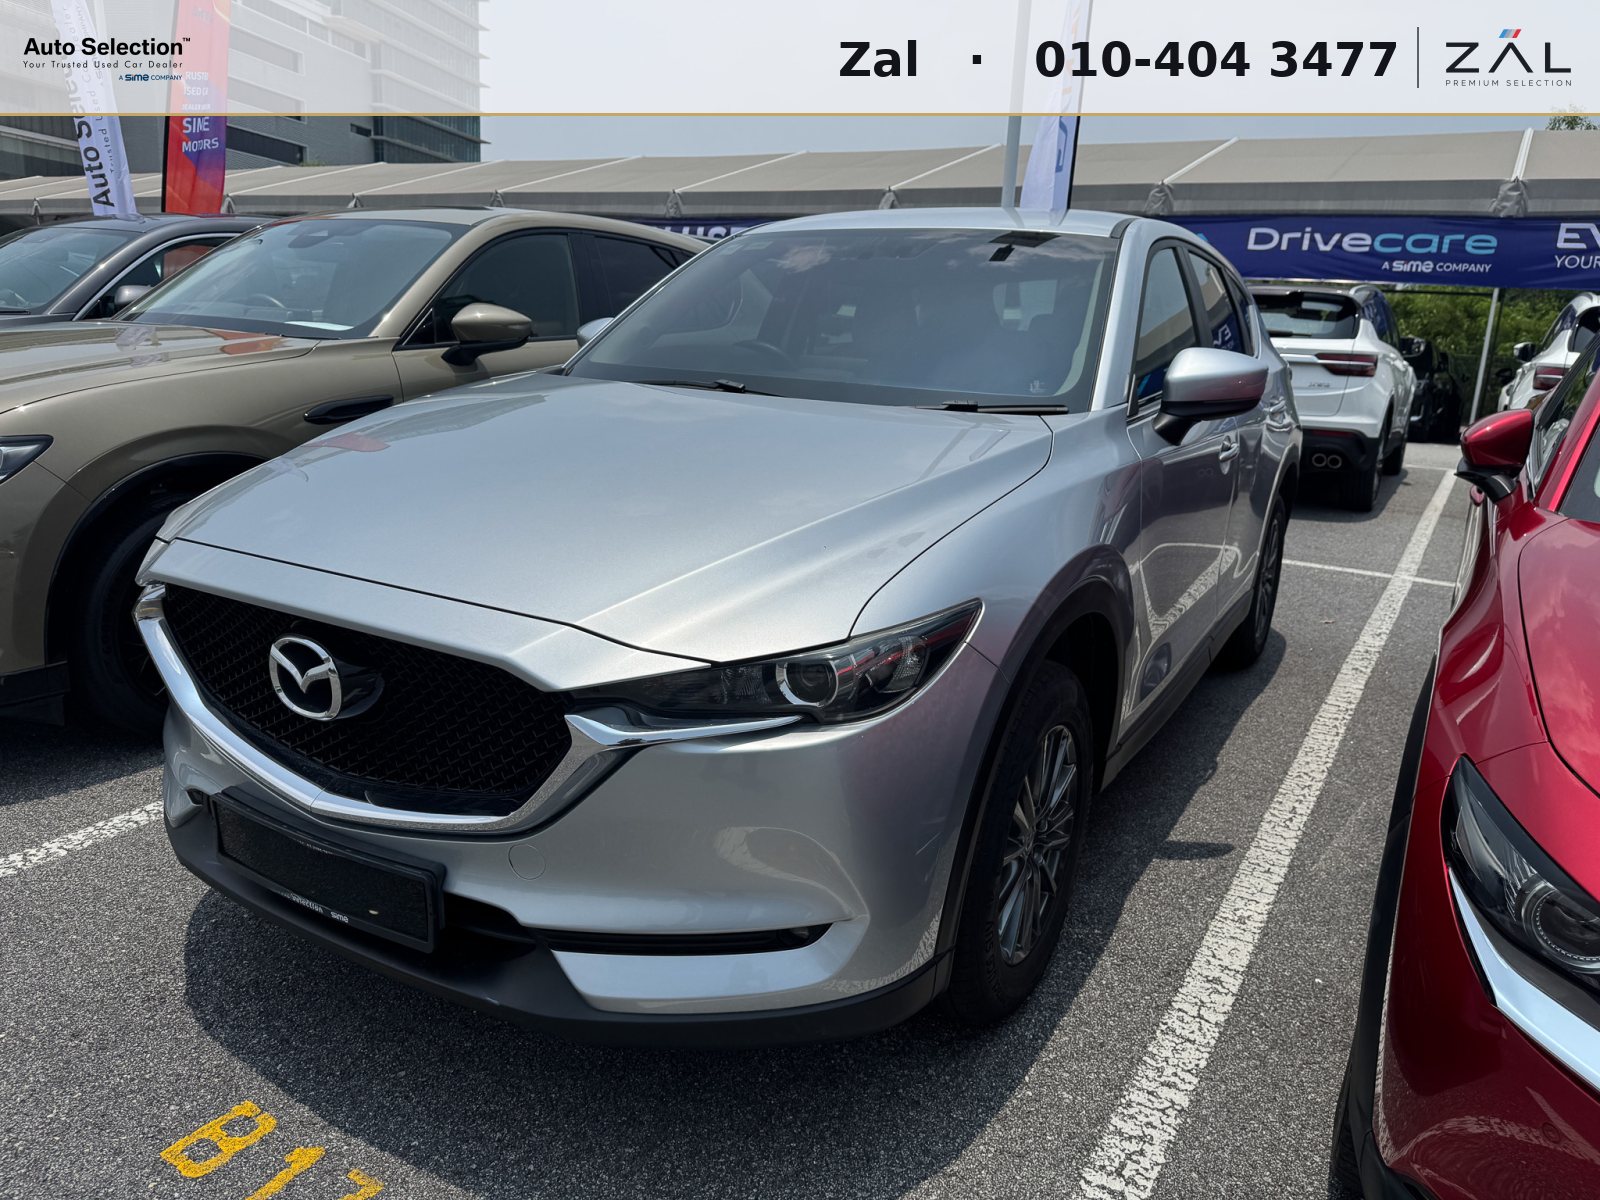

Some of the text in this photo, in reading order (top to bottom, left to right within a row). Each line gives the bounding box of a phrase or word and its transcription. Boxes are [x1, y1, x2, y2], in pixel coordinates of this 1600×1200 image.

[83, 146, 115, 207] Auto
[1247, 227, 1498, 255] Drivecare
[1381, 260, 1492, 274] A sime COMPANY
